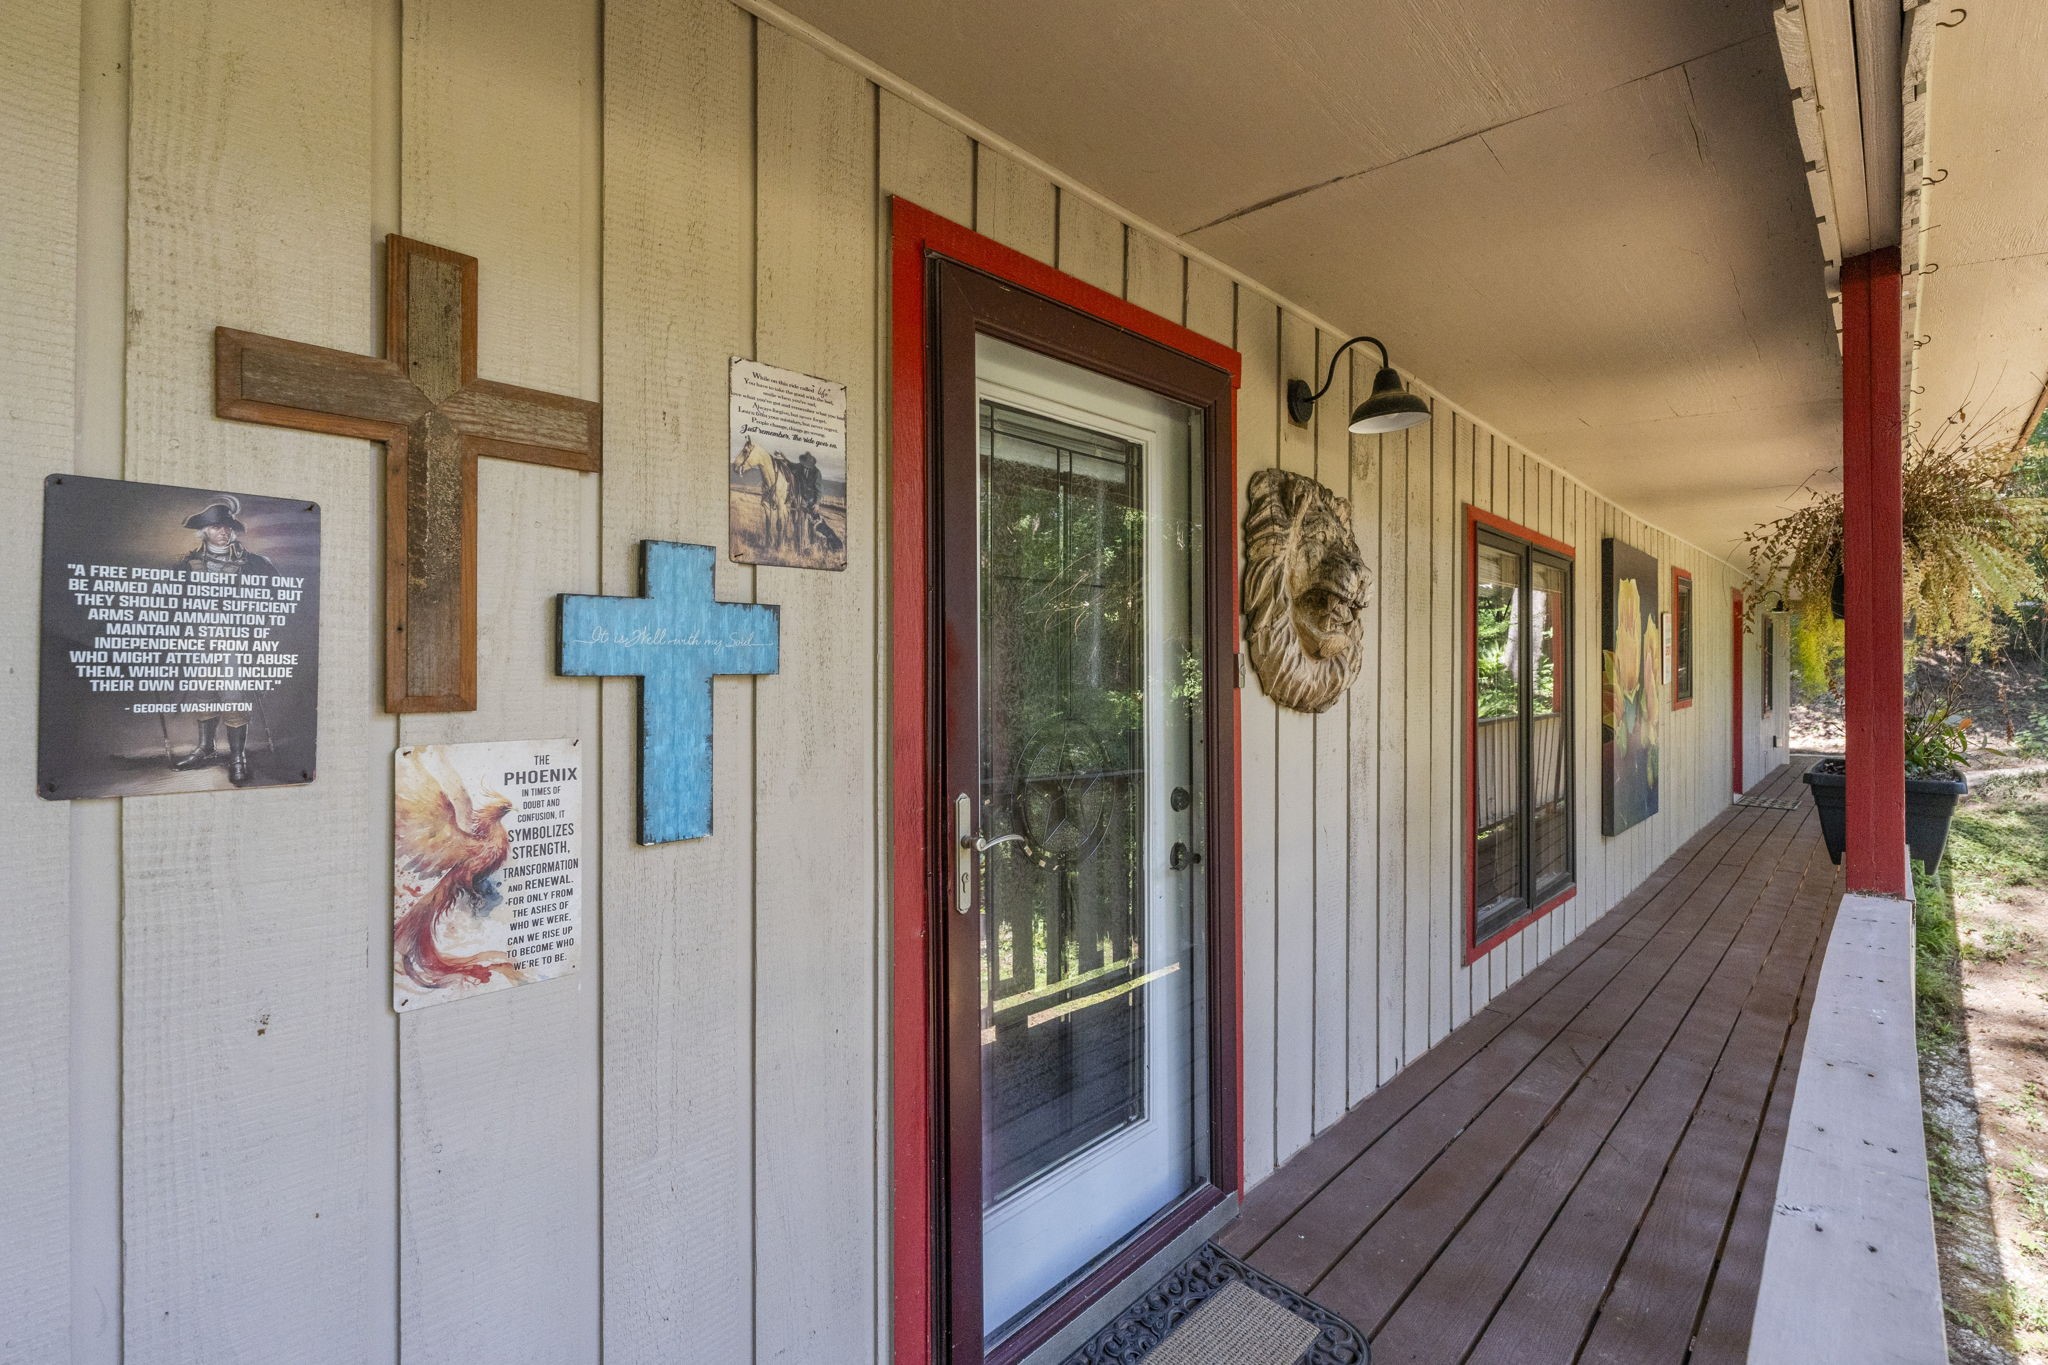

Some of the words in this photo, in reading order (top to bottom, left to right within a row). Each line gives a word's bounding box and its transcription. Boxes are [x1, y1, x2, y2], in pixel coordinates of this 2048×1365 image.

[740, 424, 758, 434] Just
[760, 428, 790, 440] remember,
[67, 563, 85, 576] "A
[91, 565, 127, 578] FREE
[132, 568, 186, 582] PEOPLE
[191, 571, 238, 584] OUGHT
[241, 574, 268, 586] NOT
[272, 576, 304, 588] ONLY
[69, 578, 88, 591] BE
[93, 581, 147, 594] ARMED
[152, 583, 182, 595] AND
[188, 585, 274, 600] DISCIPLINED,
[278, 590, 303, 601] BUT
[74, 593, 115, 606] THEY
[120, 596, 178, 609] SHOULD
[183, 598, 218, 610] HAVE
[223, 601, 297, 613] SUFFICIENT
[88, 609, 134, 621] ARMS
[138, 610, 169, 622] AND
[174, 612, 266, 625] AMMUNITION
[269, 615, 285, 626] TO
[106, 623, 180, 636] MAINTAIN
[185, 626, 194, 636] A
[199, 626, 249, 638] STATUS
[254, 628, 270, 638] OF
[95, 637, 205, 650] INDEPENDENCE
[210, 640, 248, 651] FROM
[252, 641, 280, 651] ANY
[614, 635, 626, 644] is
[625, 626, 666, 647] Well
[668, 629, 700, 645] with
[704, 637, 723, 655] my
[69, 651, 108, 663] WHO
[113, 652, 161, 663] MIGHT
[166, 653, 231, 664] ATTEMPT
[235, 654, 252, 664] TO
[256, 654, 298, 664] ABUSE
[76, 666, 124, 678] THEM,
[129, 667, 178, 677] WHICH
[184, 667, 233, 677] WOULD
[238, 667, 293, 678] INCLUDE
[90, 680, 134, 691] THEIR
[139, 680, 174, 691] OWN
[179, 680, 281, 691] GOVERNMENT."
[134, 704, 177, 713] GEORGE
[181, 703, 252, 712] WASHINGTON
[534, 755, 550, 765] THE
[504, 767, 577, 786] PHOENIX
[532, 787, 551, 796] TIMES
[553, 786, 561, 794] OF
[523, 800, 544, 809] DOUBT
[508, 823, 574, 842] SYMBOLIZES
[512, 841, 570, 860] STRENGTH,
[503, 858, 578, 878] TRANSFORMATION
[508, 884, 522, 892] AND
[508, 896, 524, 906] FOR
[527, 893, 548, 903] ONLY
[551, 888, 573, 900] FROM
[513, 908, 528, 918] THE
[531, 903, 556, 915] ASHES
[560, 901, 569, 910] OF
[510, 921, 529, 931] WHO
[532, 918, 544, 926] WE
[507, 936, 524, 946] CAN
[527, 932, 539, 942] WE
[542, 929, 560, 938] RISE
[563, 926, 572, 935] UP
[507, 950, 517, 958] TO
[520, 942, 554, 956] BECOME
[556, 938, 574, 948] WHO
[514, 958, 539, 970] WE'RE
[542, 956, 552, 965] TO
[555, 953, 567, 962] BE.
